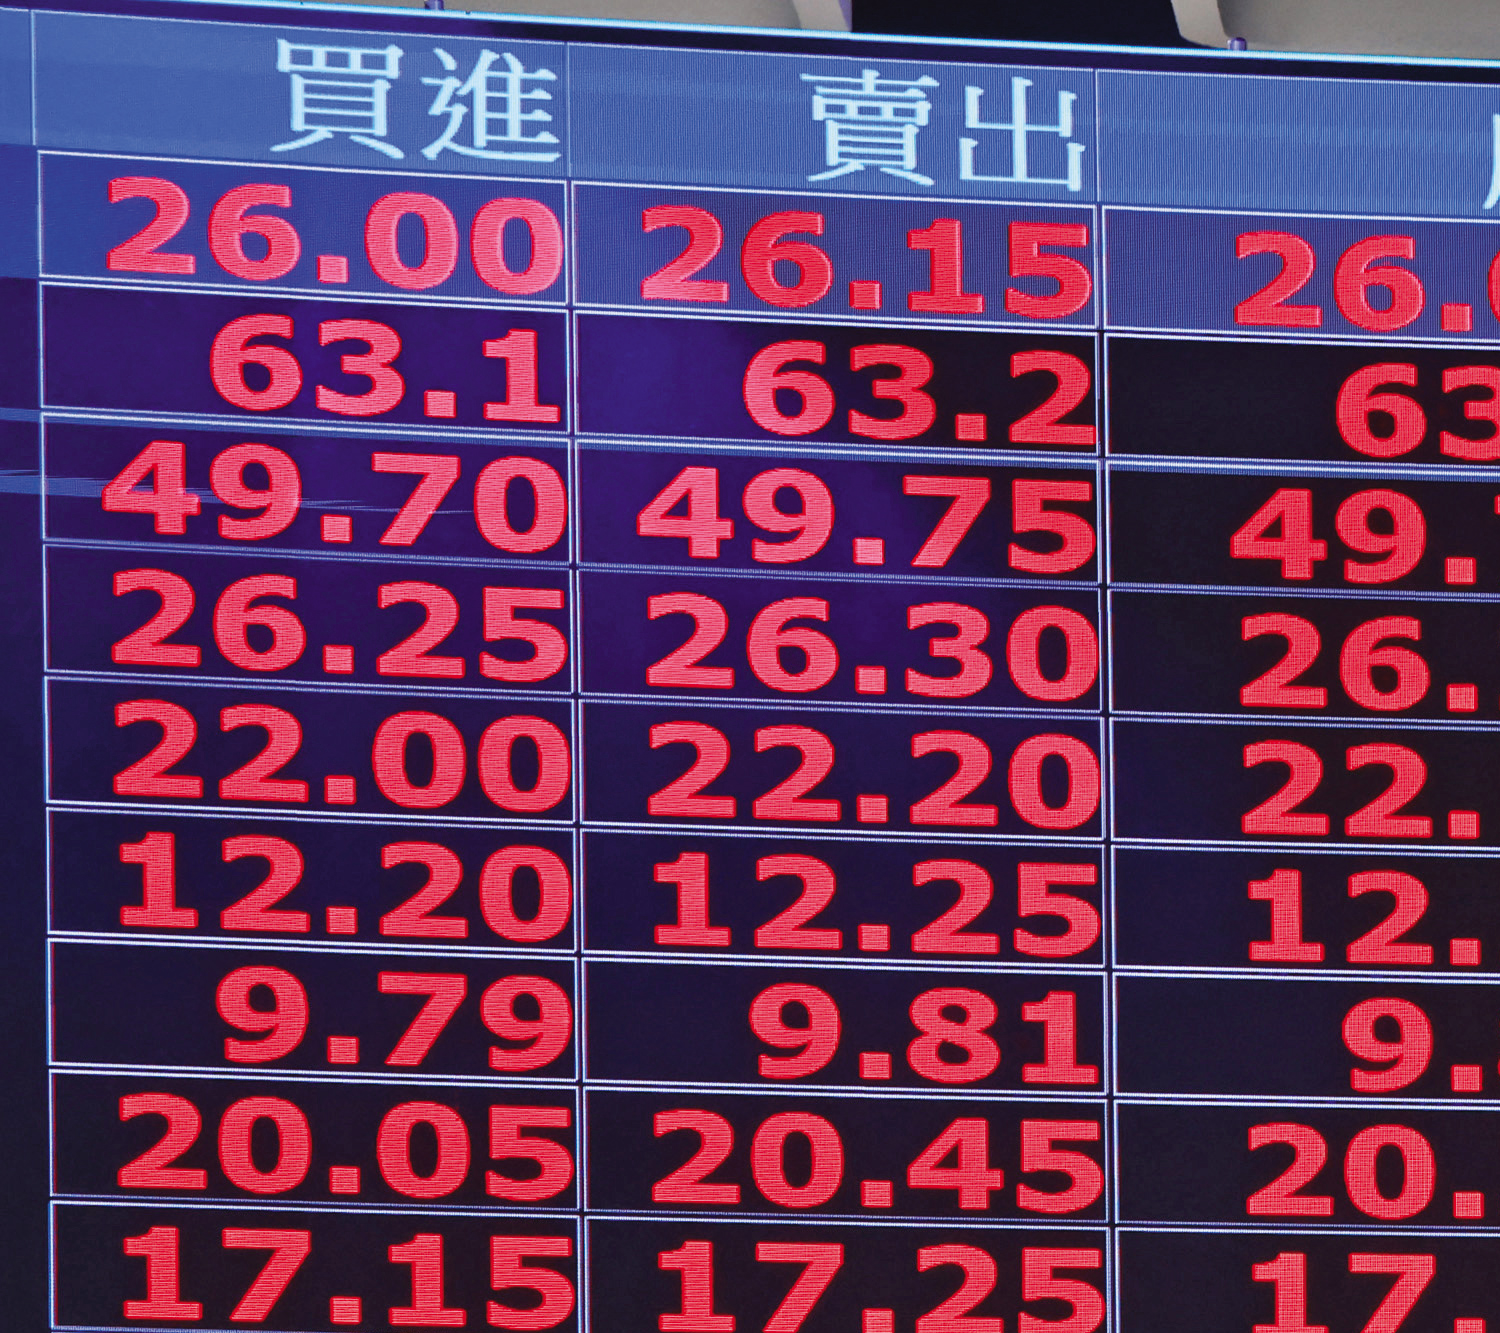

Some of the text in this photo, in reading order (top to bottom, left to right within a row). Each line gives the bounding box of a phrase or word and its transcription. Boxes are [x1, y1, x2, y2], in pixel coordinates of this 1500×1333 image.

[264, 40, 560, 166] 買進
[800, 70, 1084, 195] 賣出
[107, 177, 564, 295] 26.00
[640, 205, 1092, 319] 26.15
[216, 966, 572, 1071] 9.79
[749, 983, 1098, 1084] 9.81
